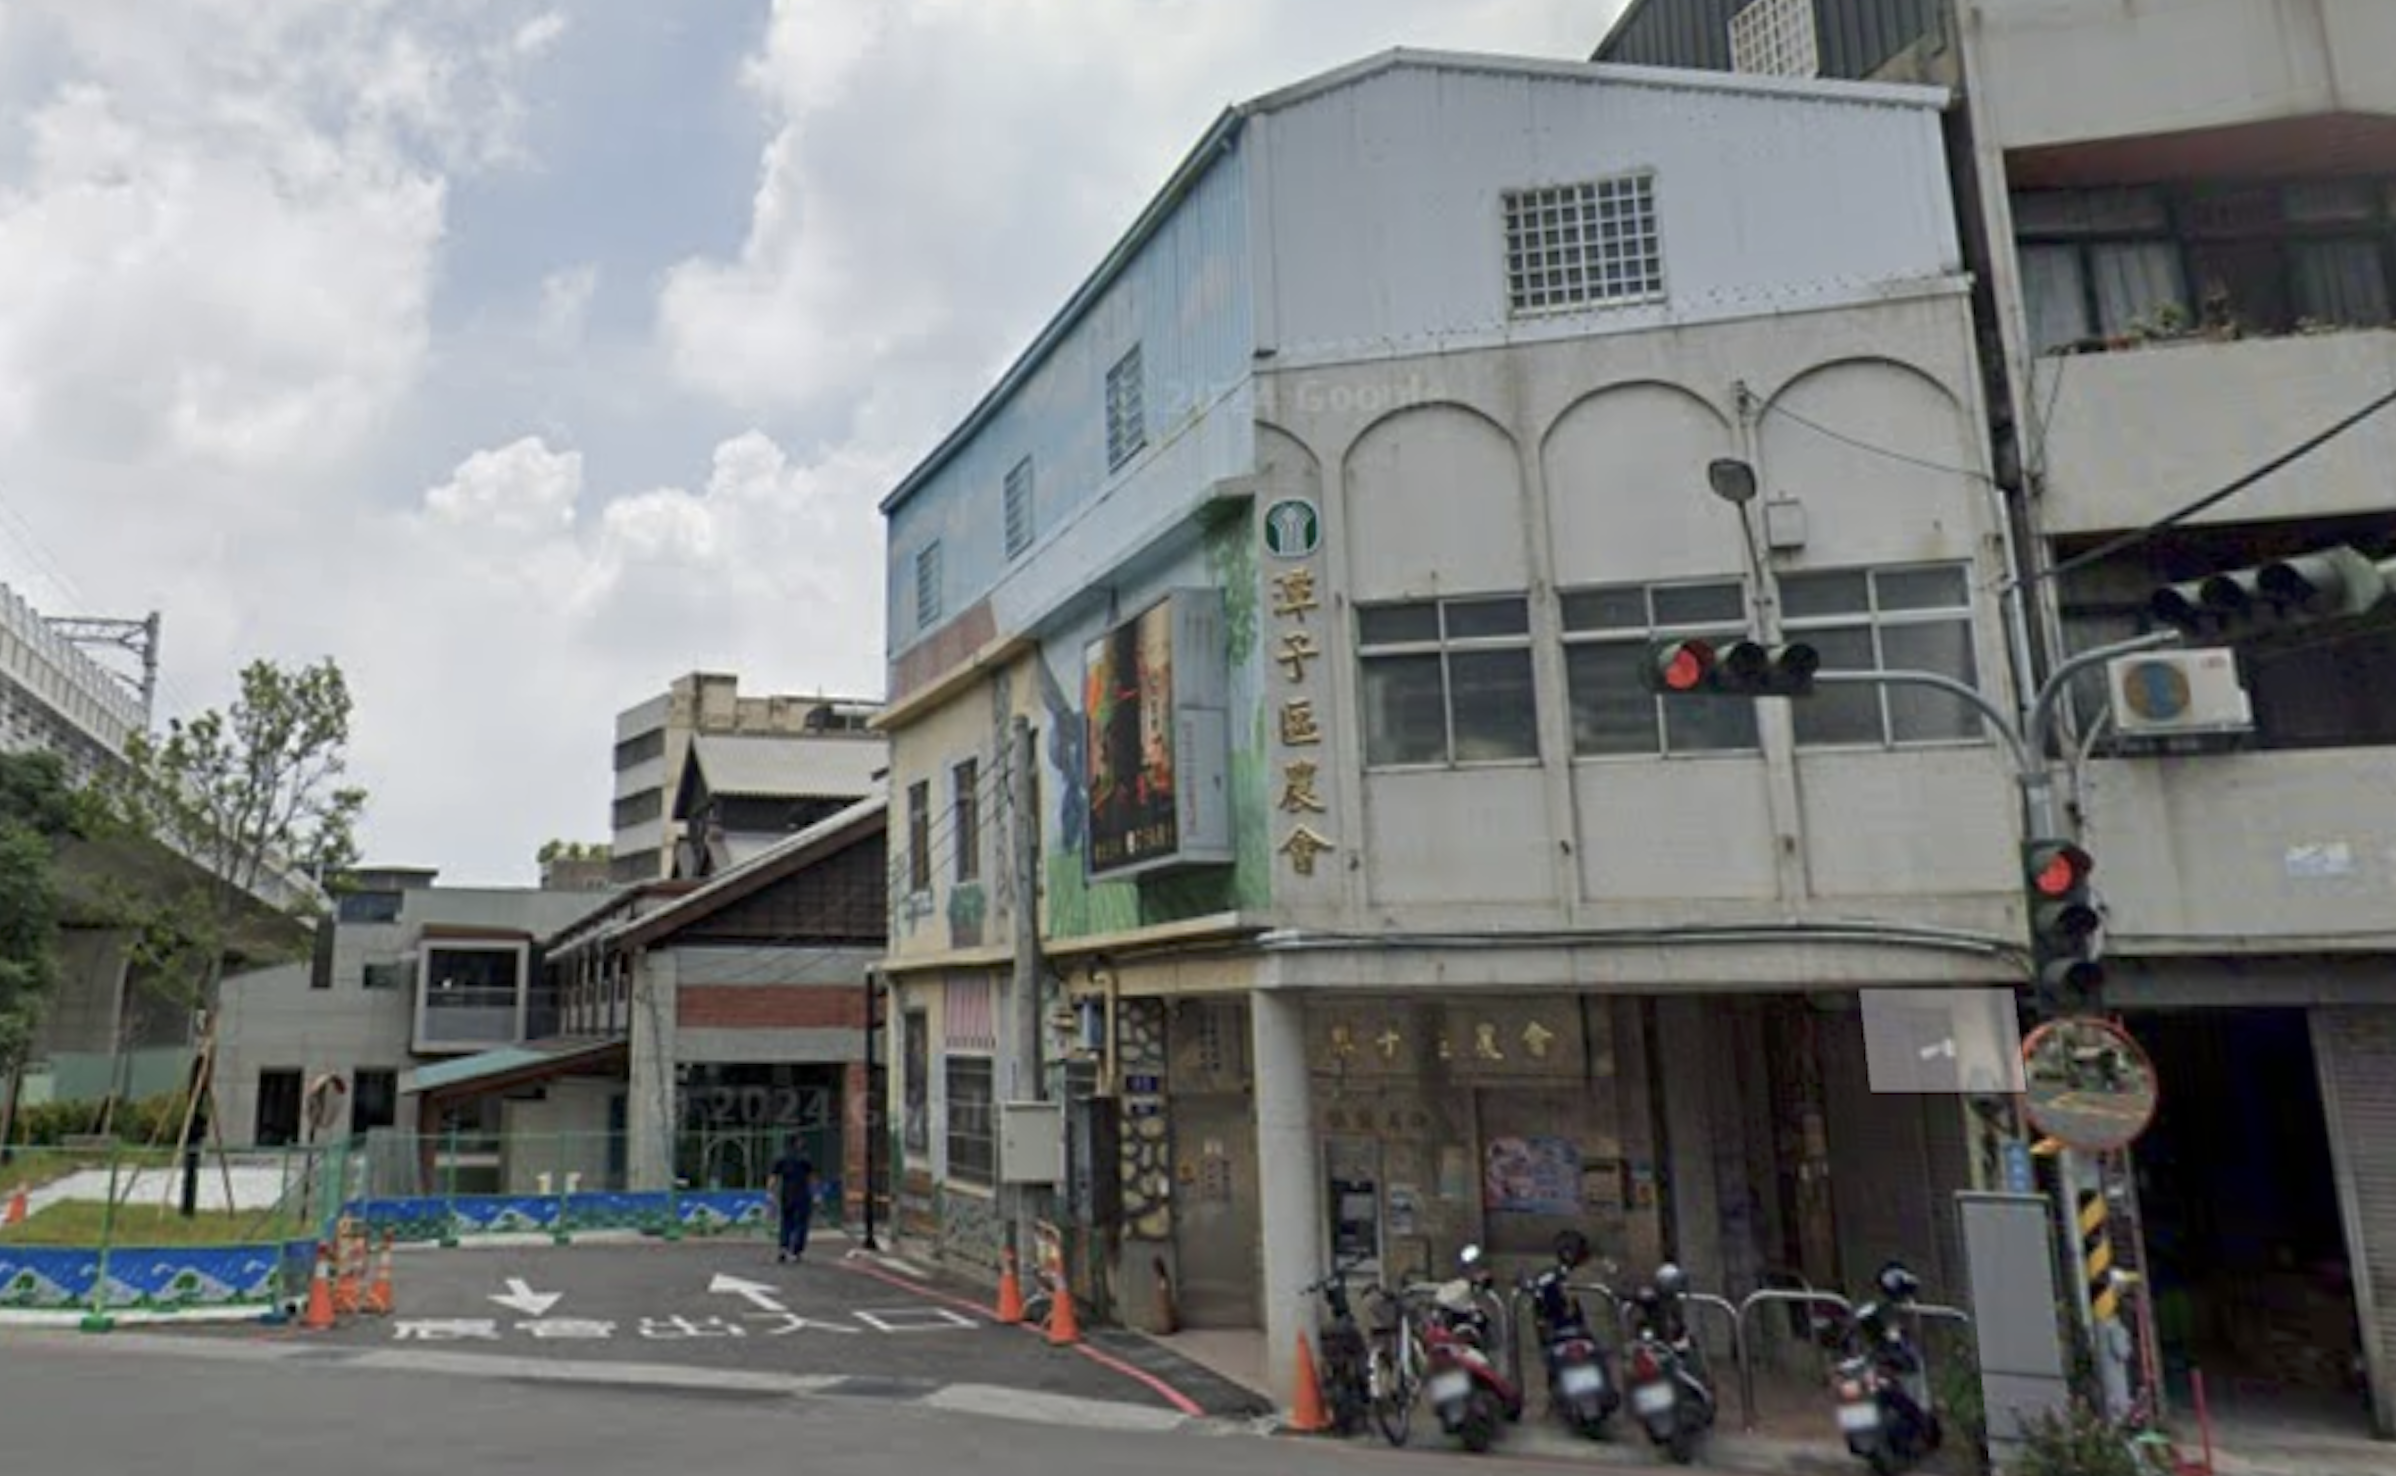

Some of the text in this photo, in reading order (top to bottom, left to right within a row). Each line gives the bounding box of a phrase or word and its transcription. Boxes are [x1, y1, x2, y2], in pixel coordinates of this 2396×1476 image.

[1272, 568, 1335, 876] 潭子區農會
